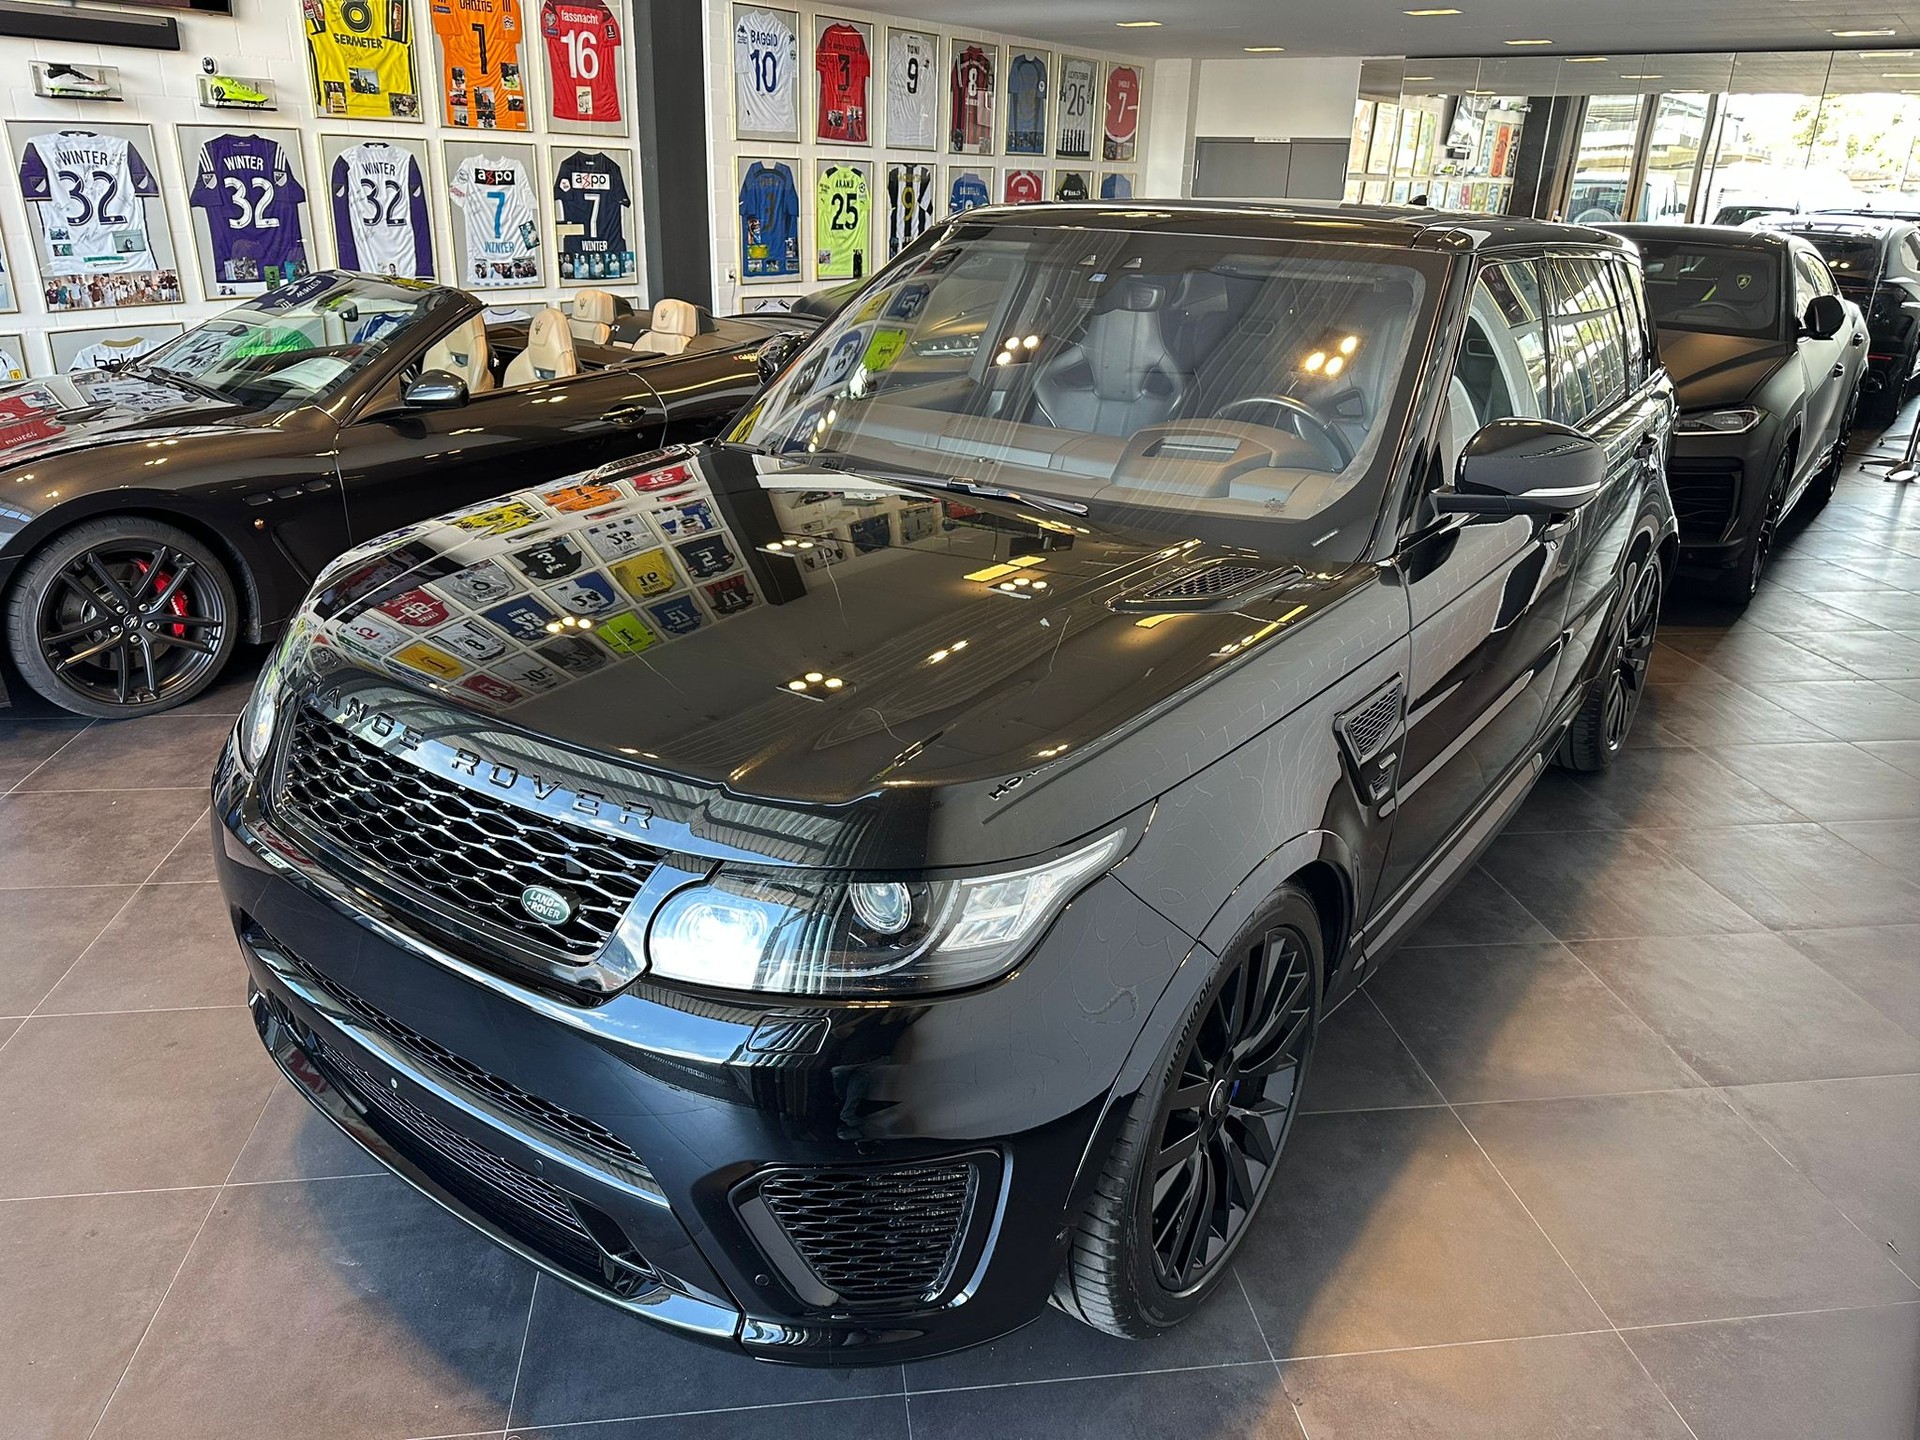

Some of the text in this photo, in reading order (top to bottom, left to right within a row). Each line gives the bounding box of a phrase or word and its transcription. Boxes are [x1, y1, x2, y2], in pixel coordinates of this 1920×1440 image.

[561, 10, 599, 25] fassnacht
[472, 23, 488, 74] 1
[561, 29, 599, 80] 16
[751, 30, 778, 47] BAGGIO
[750, 49, 777, 93] 10
[907, 58, 918, 94] 9
[1067, 83, 1085, 116] 26
[58, 150, 108, 166] WINTER
[223, 155, 264, 171] WINTER
[361, 162, 396, 177] WINTER
[58, 170, 128, 227] 32
[223, 176, 280, 229] 32
[360, 178, 407, 227] 32
[487, 191, 506, 239] 7
[584, 193, 601, 238] 7
[831, 192, 859, 231] 25
[901, 186, 915, 222] 9
[581, 240, 608, 252] WINTER
[304, 672, 655, 830] RANGE ROVER
[530, 891, 556, 907] LAND
[530, 901, 561, 919] ROVER
